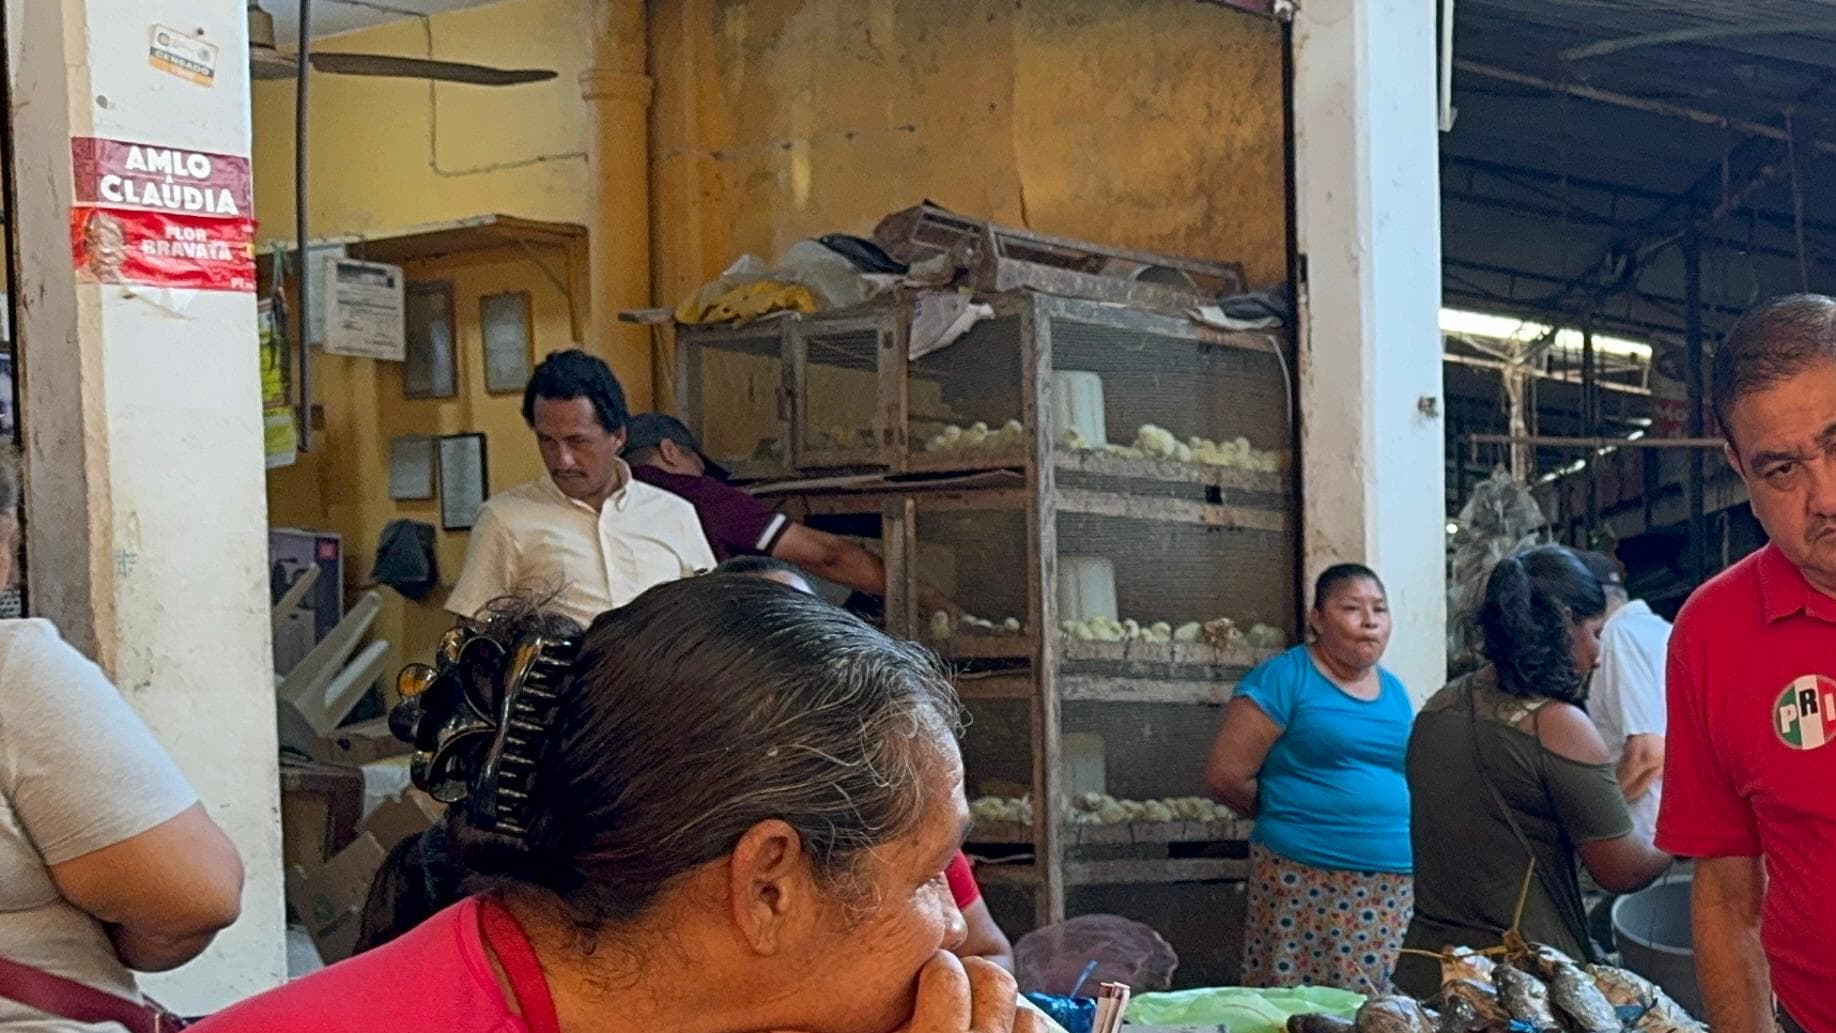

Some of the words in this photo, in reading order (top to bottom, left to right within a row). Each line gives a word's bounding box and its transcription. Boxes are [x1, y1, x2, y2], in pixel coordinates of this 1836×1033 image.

[155, 50, 209, 75] CENSADO
[125, 146, 211, 179] AMLO
[100, 174, 239, 215] CLAUDIA
[164, 225, 207, 242] FLOR
[139, 239, 233, 261] BRAVATA
[1780, 688, 1836, 734] PRI
